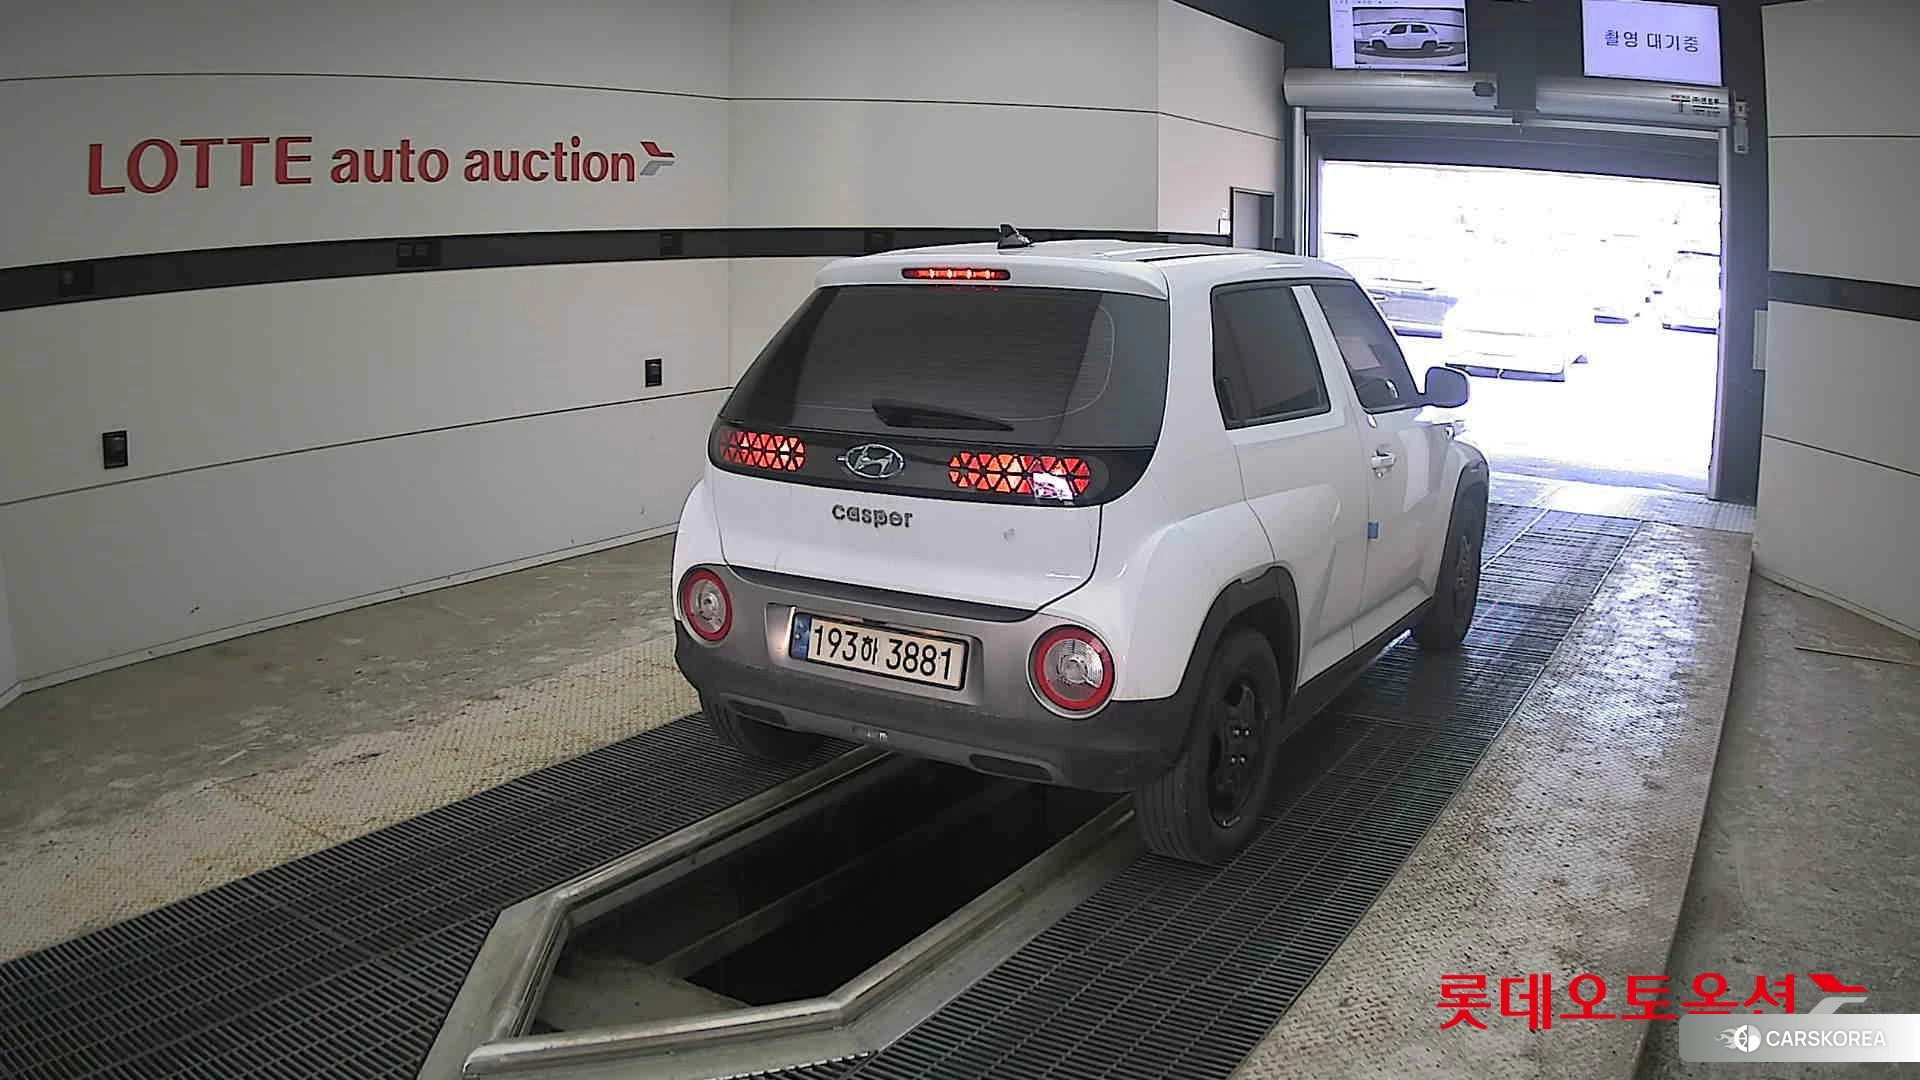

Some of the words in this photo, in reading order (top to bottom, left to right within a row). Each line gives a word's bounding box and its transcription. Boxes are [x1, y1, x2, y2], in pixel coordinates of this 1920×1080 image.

[1604, 29, 1638, 48] 촬영
[1646, 33, 1698, 53] 대기중
[87, 136, 312, 196] LOTTE
[330, 139, 450, 184] auto
[463, 135, 635, 182] auction
[831, 504, 913, 528] casper
[814, 625, 878, 665] 193하
[886, 638, 952, 680] 3881
